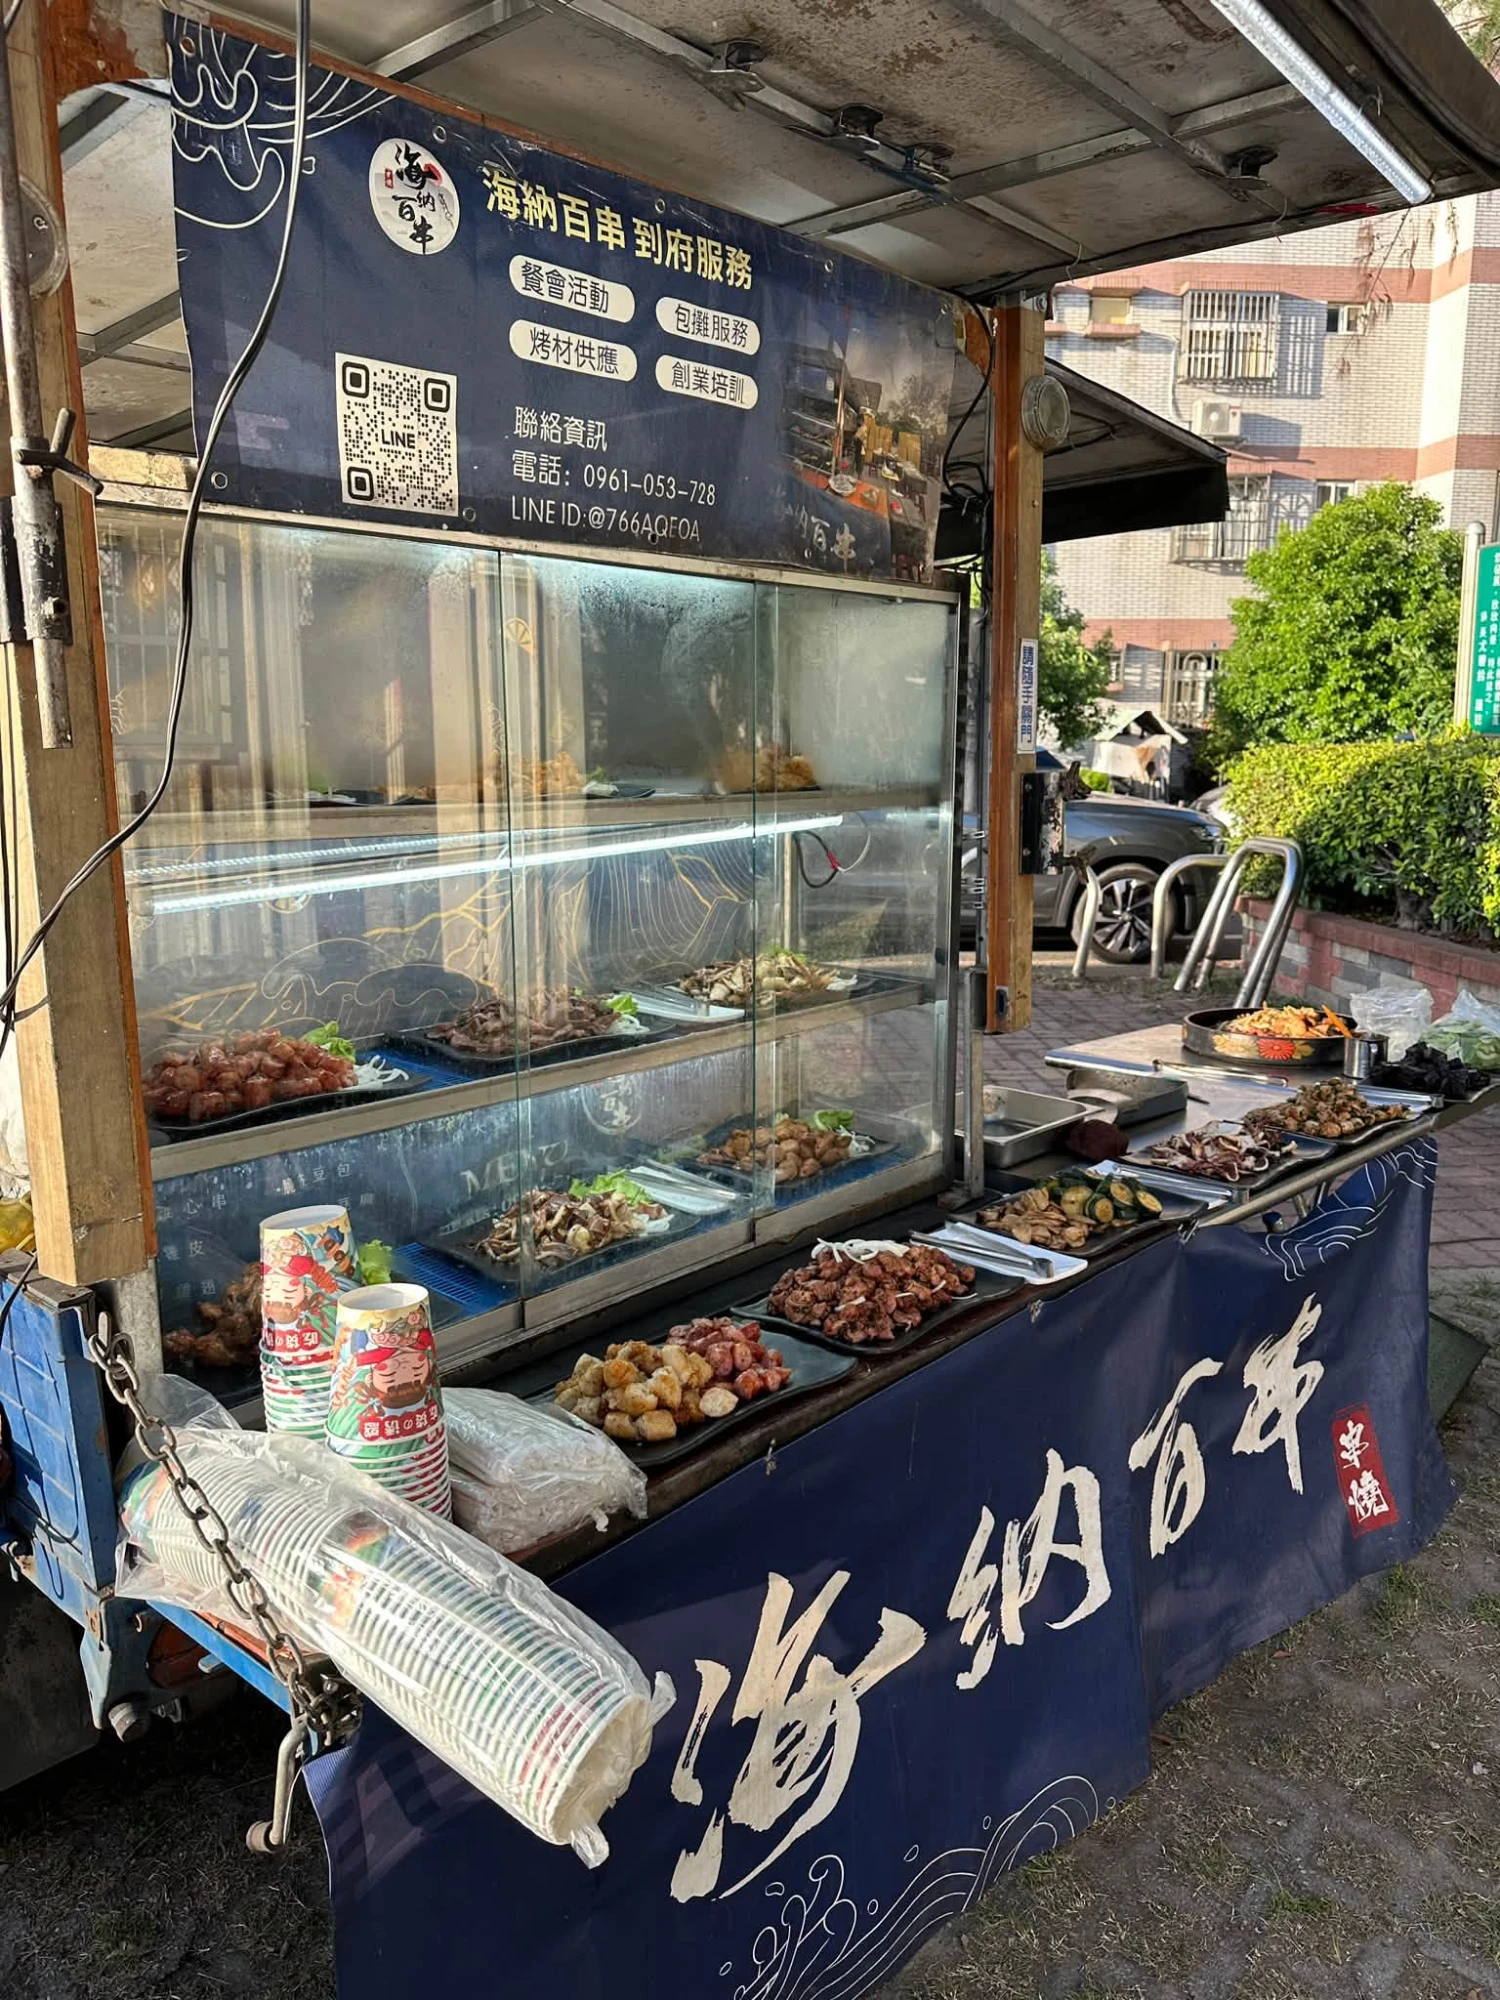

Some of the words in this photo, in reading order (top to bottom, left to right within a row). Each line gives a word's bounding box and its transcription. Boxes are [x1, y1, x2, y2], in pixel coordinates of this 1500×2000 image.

[483, 169, 626, 251] 海納百串
[632, 216, 753, 290] 到府服務
[521, 260, 609, 314] 餐會活動
[674, 304, 749, 348] 包攤服務
[529, 326, 620, 376] 烤材供應
[671, 360, 745, 405] 創業培訓
[381, 428, 415, 449] LINE
[513, 406, 608, 452] 聯絡資訊
[583, 463, 716, 506] 0961-053-728
[511, 495, 556, 525] LINE
[1338, 1420, 1389, 1522] 串燒
